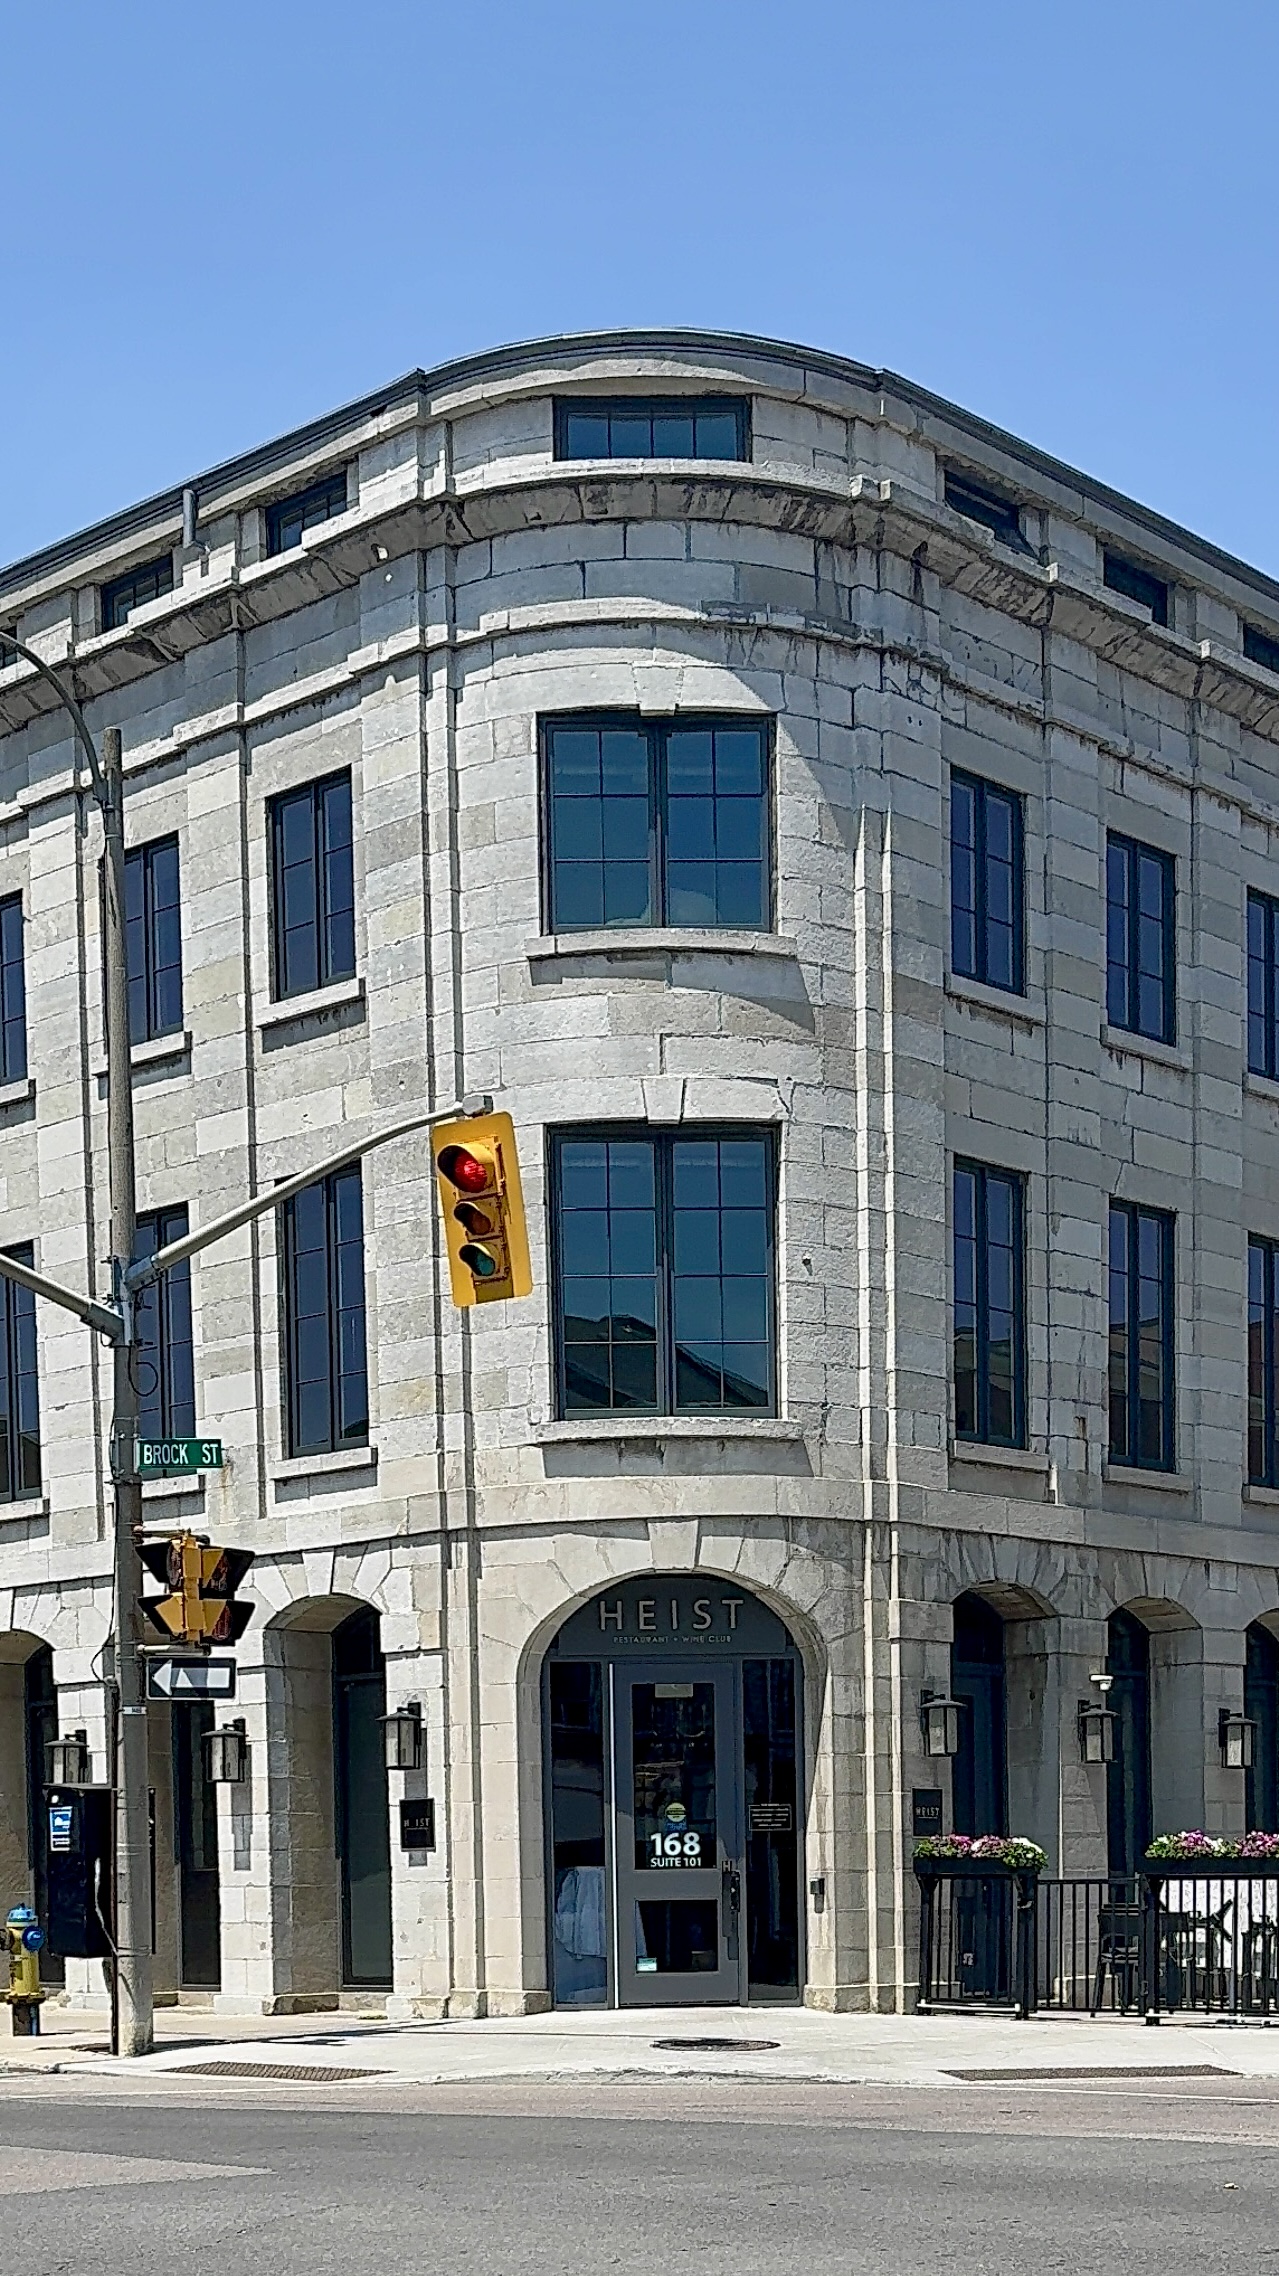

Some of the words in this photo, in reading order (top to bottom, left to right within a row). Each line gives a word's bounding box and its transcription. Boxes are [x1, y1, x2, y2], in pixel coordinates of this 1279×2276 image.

[143, 1444, 189, 1465] BROCK
[201, 1443, 219, 1464] ST
[600, 1599, 744, 1631] HEIST
[681, 1635, 705, 1644] WINE
[708, 1635, 732, 1644] CLUB
[403, 1817, 431, 1828] HIST
[650, 1831, 701, 1856] 168
[650, 1856, 682, 1868] SUITE
[683, 1856, 702, 1867] 101
